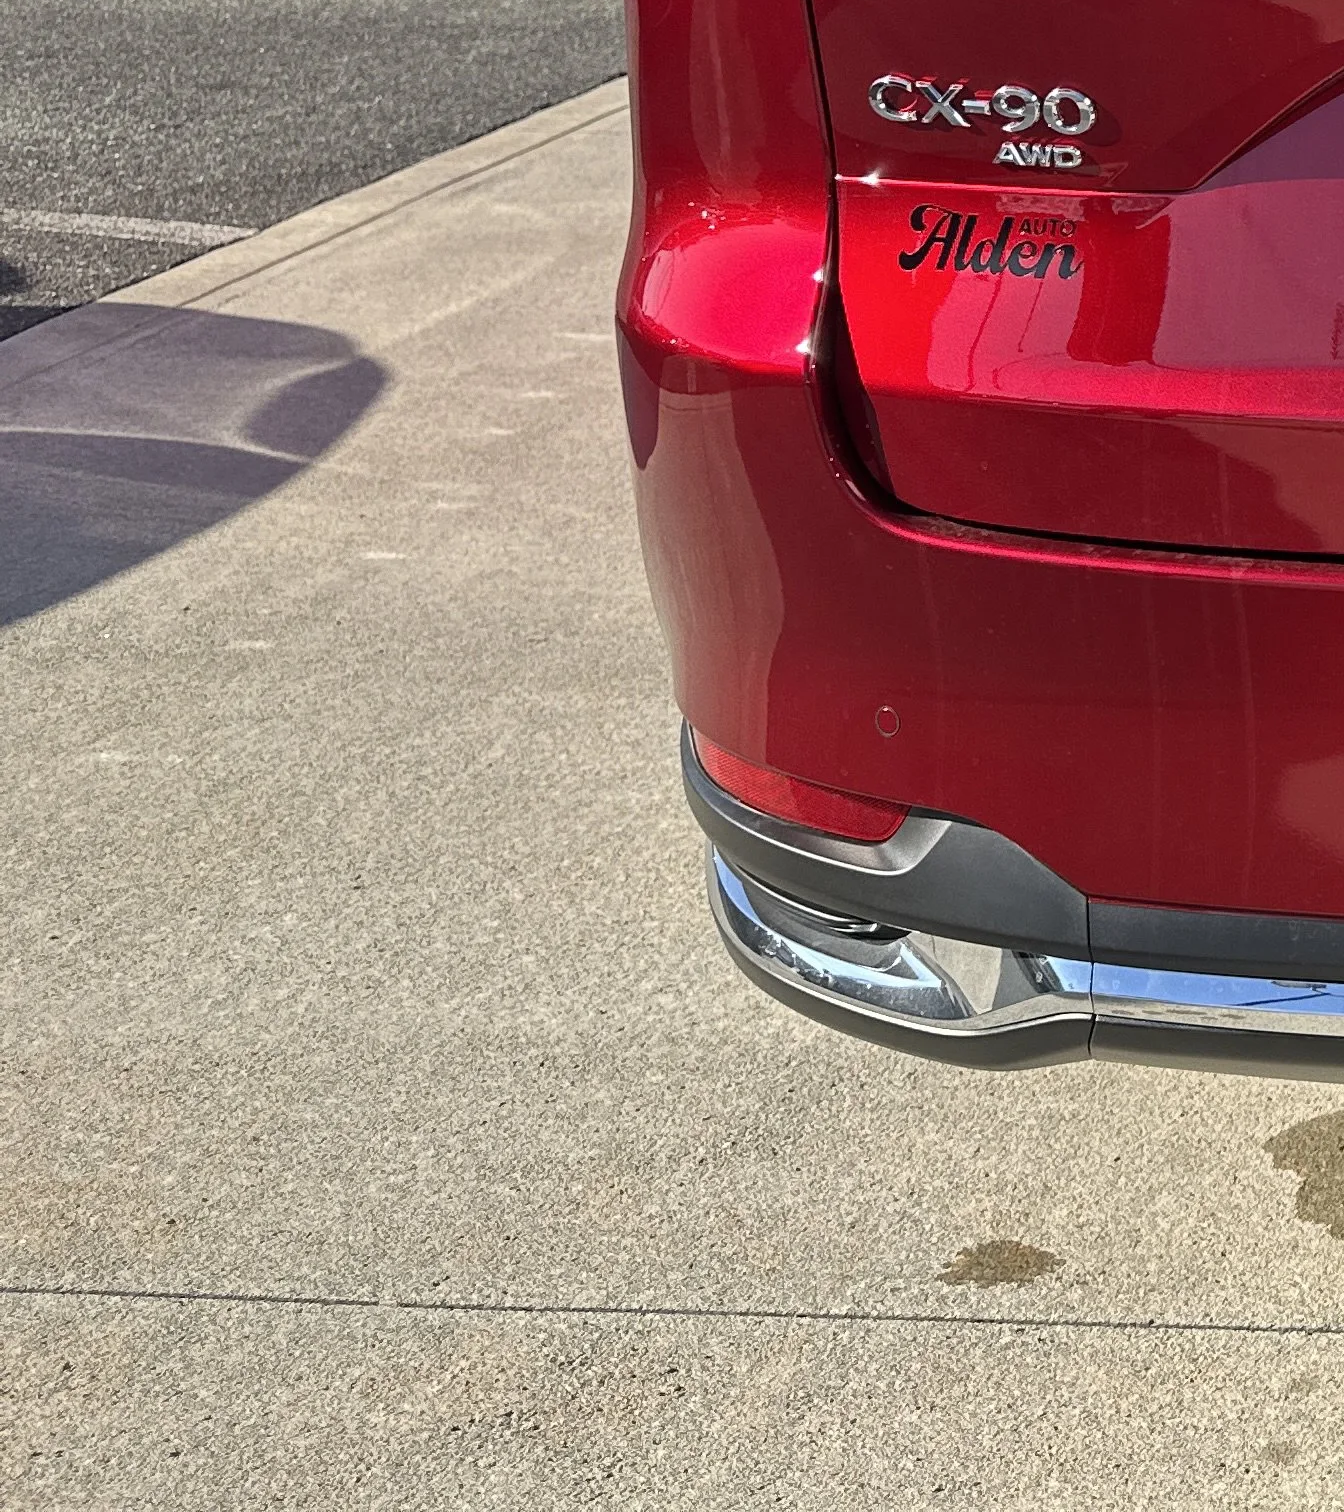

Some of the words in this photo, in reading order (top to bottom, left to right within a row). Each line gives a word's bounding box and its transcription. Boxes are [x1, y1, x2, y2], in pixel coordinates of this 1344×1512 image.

[868, 73, 1098, 135] CX-90
[992, 140, 1083, 169] AWD
[897, 203, 1083, 281] Alden
[1018, 217, 1077, 238] AUTO
